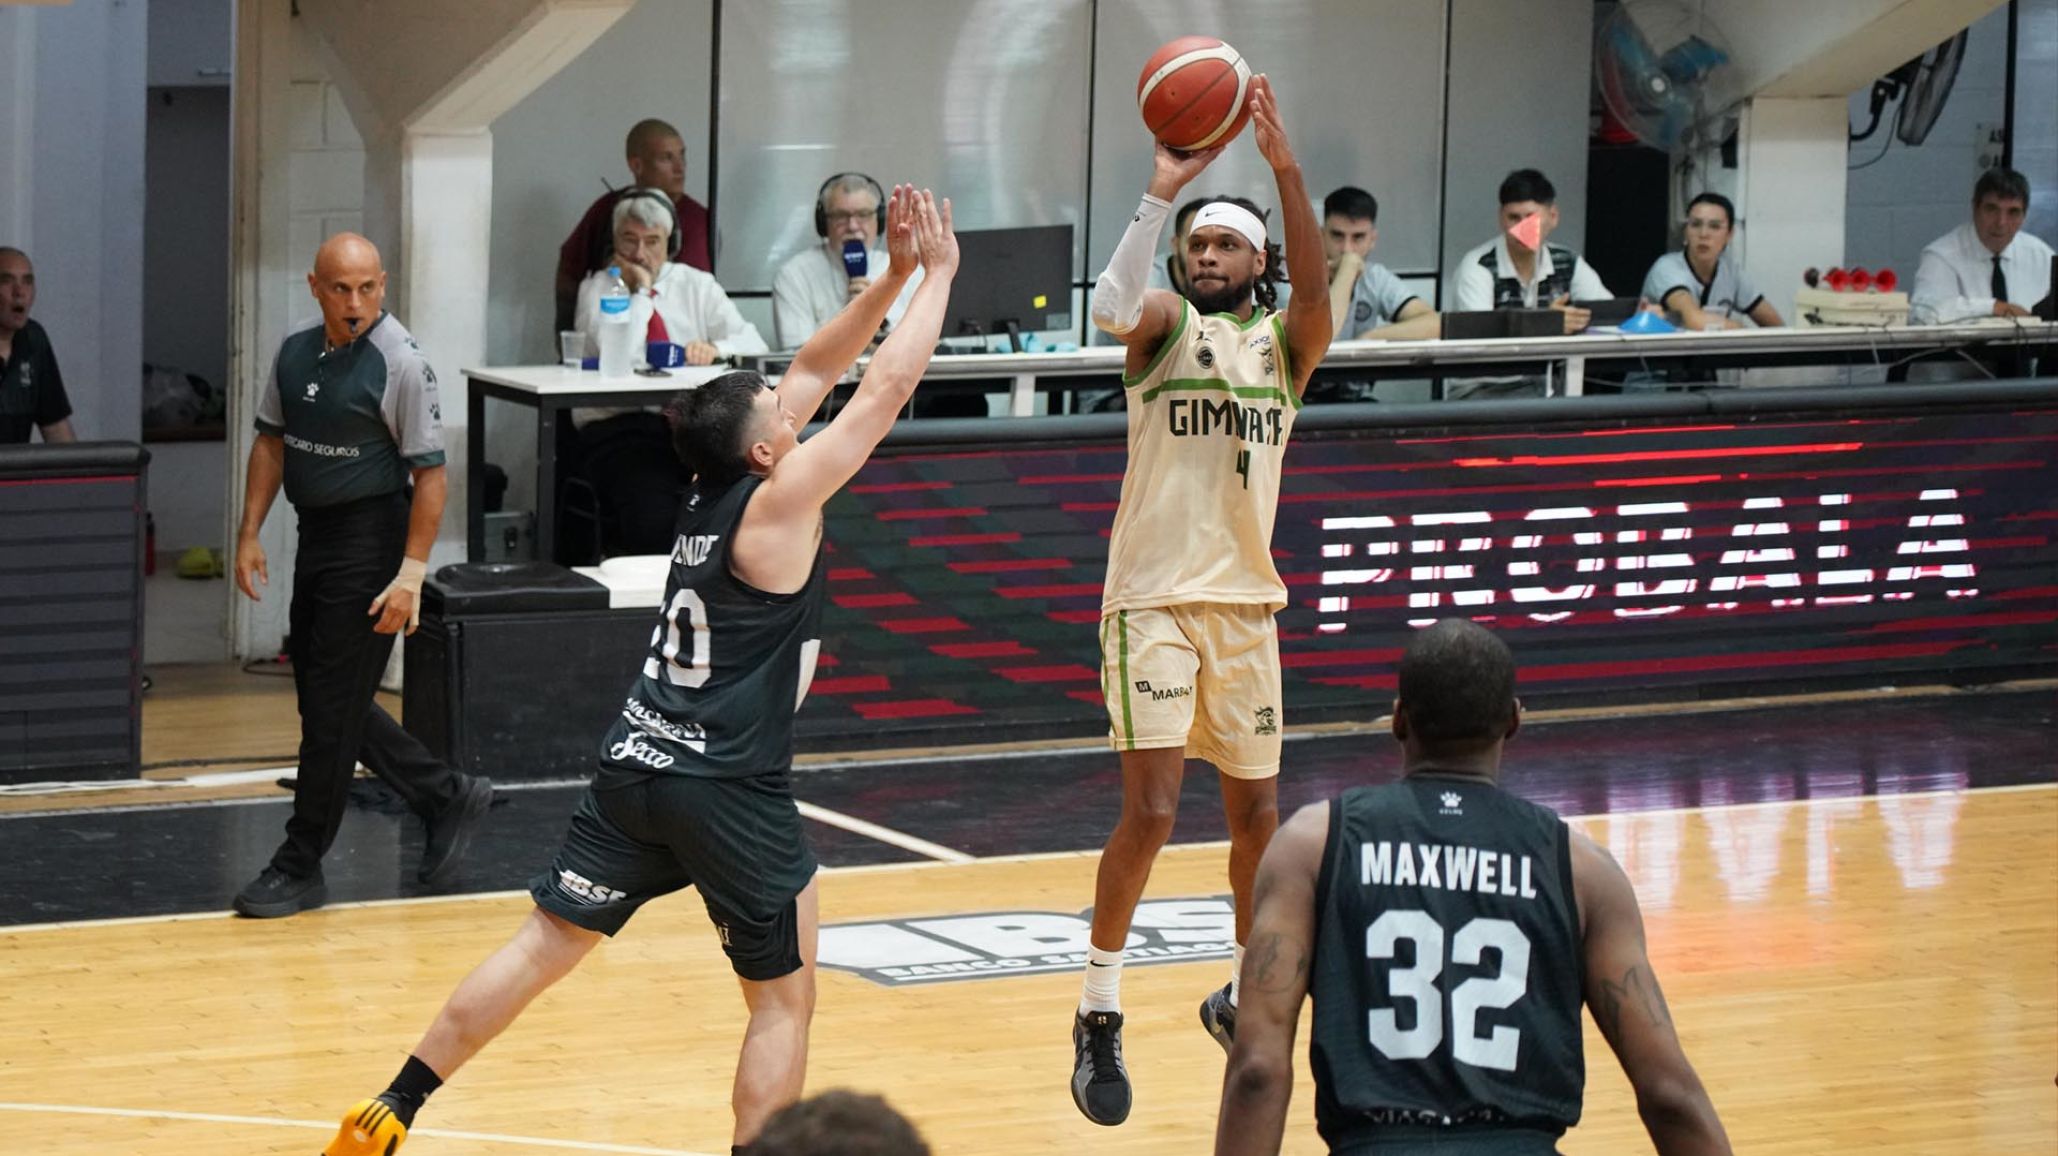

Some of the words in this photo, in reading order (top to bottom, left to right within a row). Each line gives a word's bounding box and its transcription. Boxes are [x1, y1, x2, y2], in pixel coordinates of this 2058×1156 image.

[1236, 450, 1251, 490] 4
[1318, 488, 1978, 632] PROBALA
[643, 588, 712, 689] 0
[1361, 841, 1537, 900] MAXWELL
[1365, 908, 1532, 1072] 32
